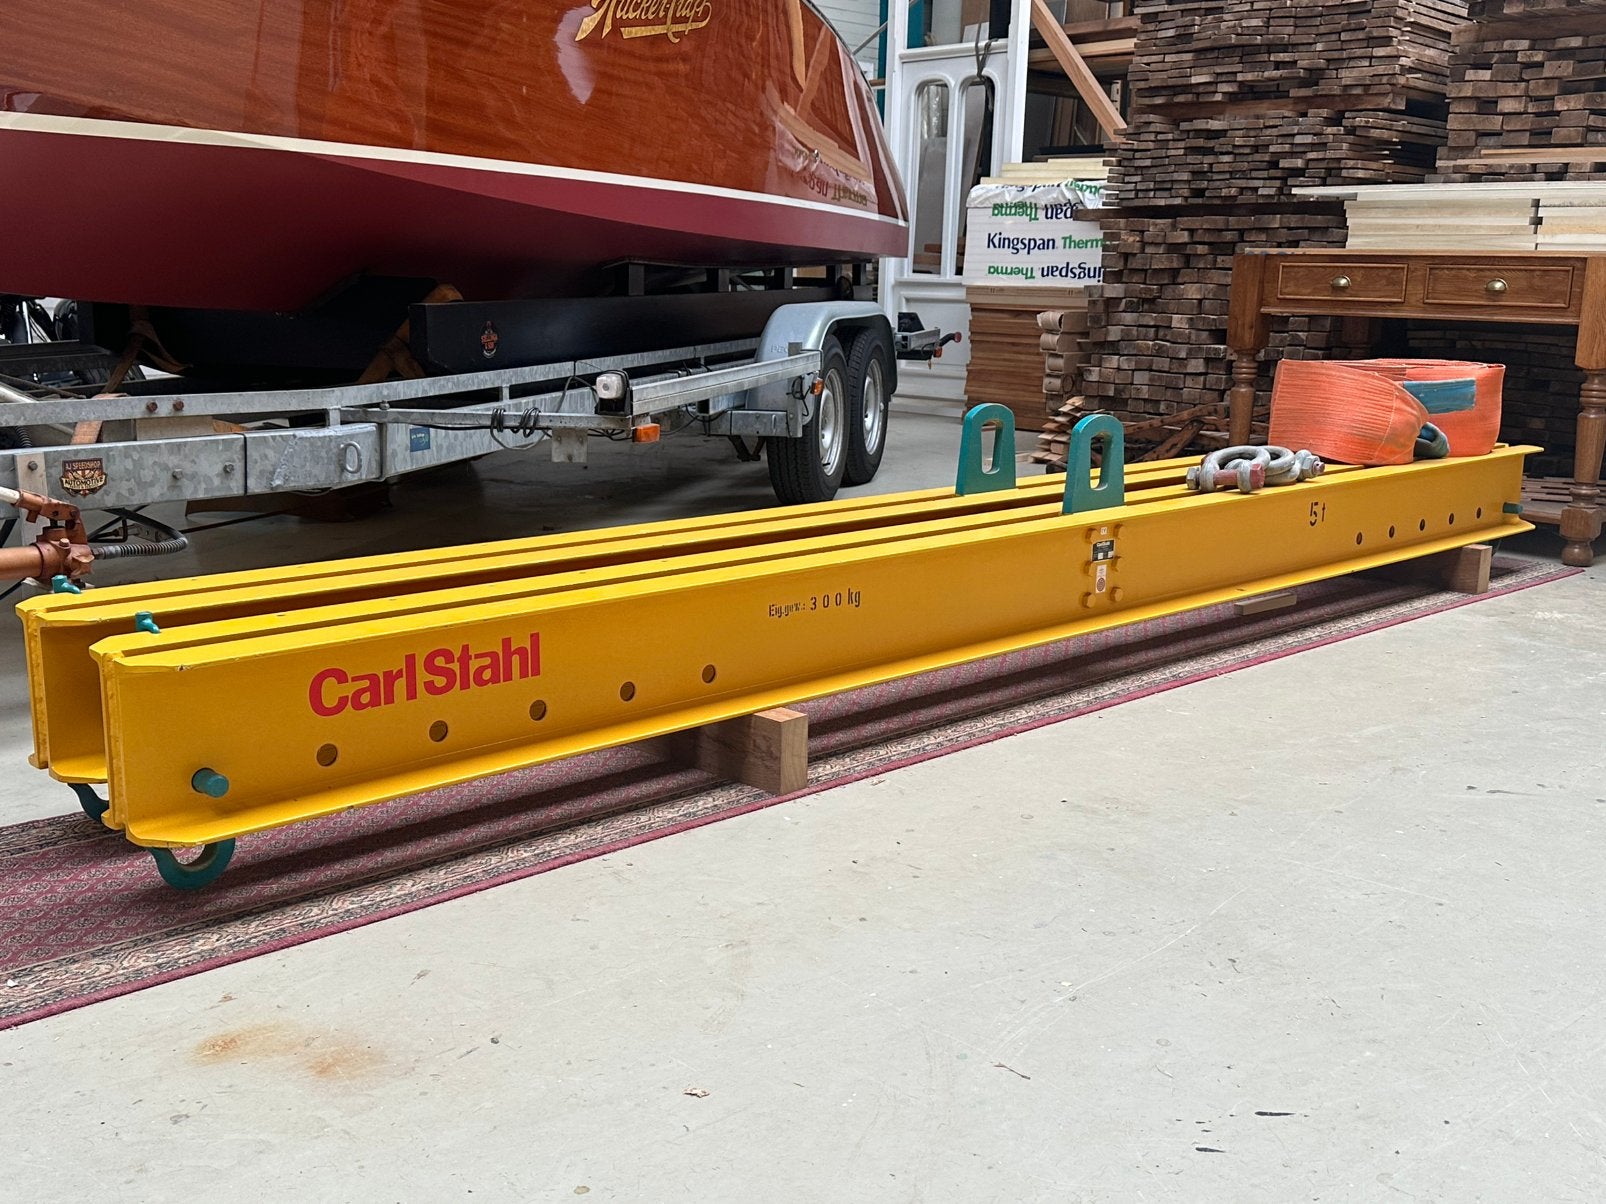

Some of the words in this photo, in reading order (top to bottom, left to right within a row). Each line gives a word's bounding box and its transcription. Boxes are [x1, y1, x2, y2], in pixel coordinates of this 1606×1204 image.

[986, 232, 1056, 254] Kingspan
[1061, 235, 1104, 250] Therm
[988, 265, 1036, 280] Therma
[1041, 261, 1104, 283] ingspan
[847, 587, 861, 608] kg
